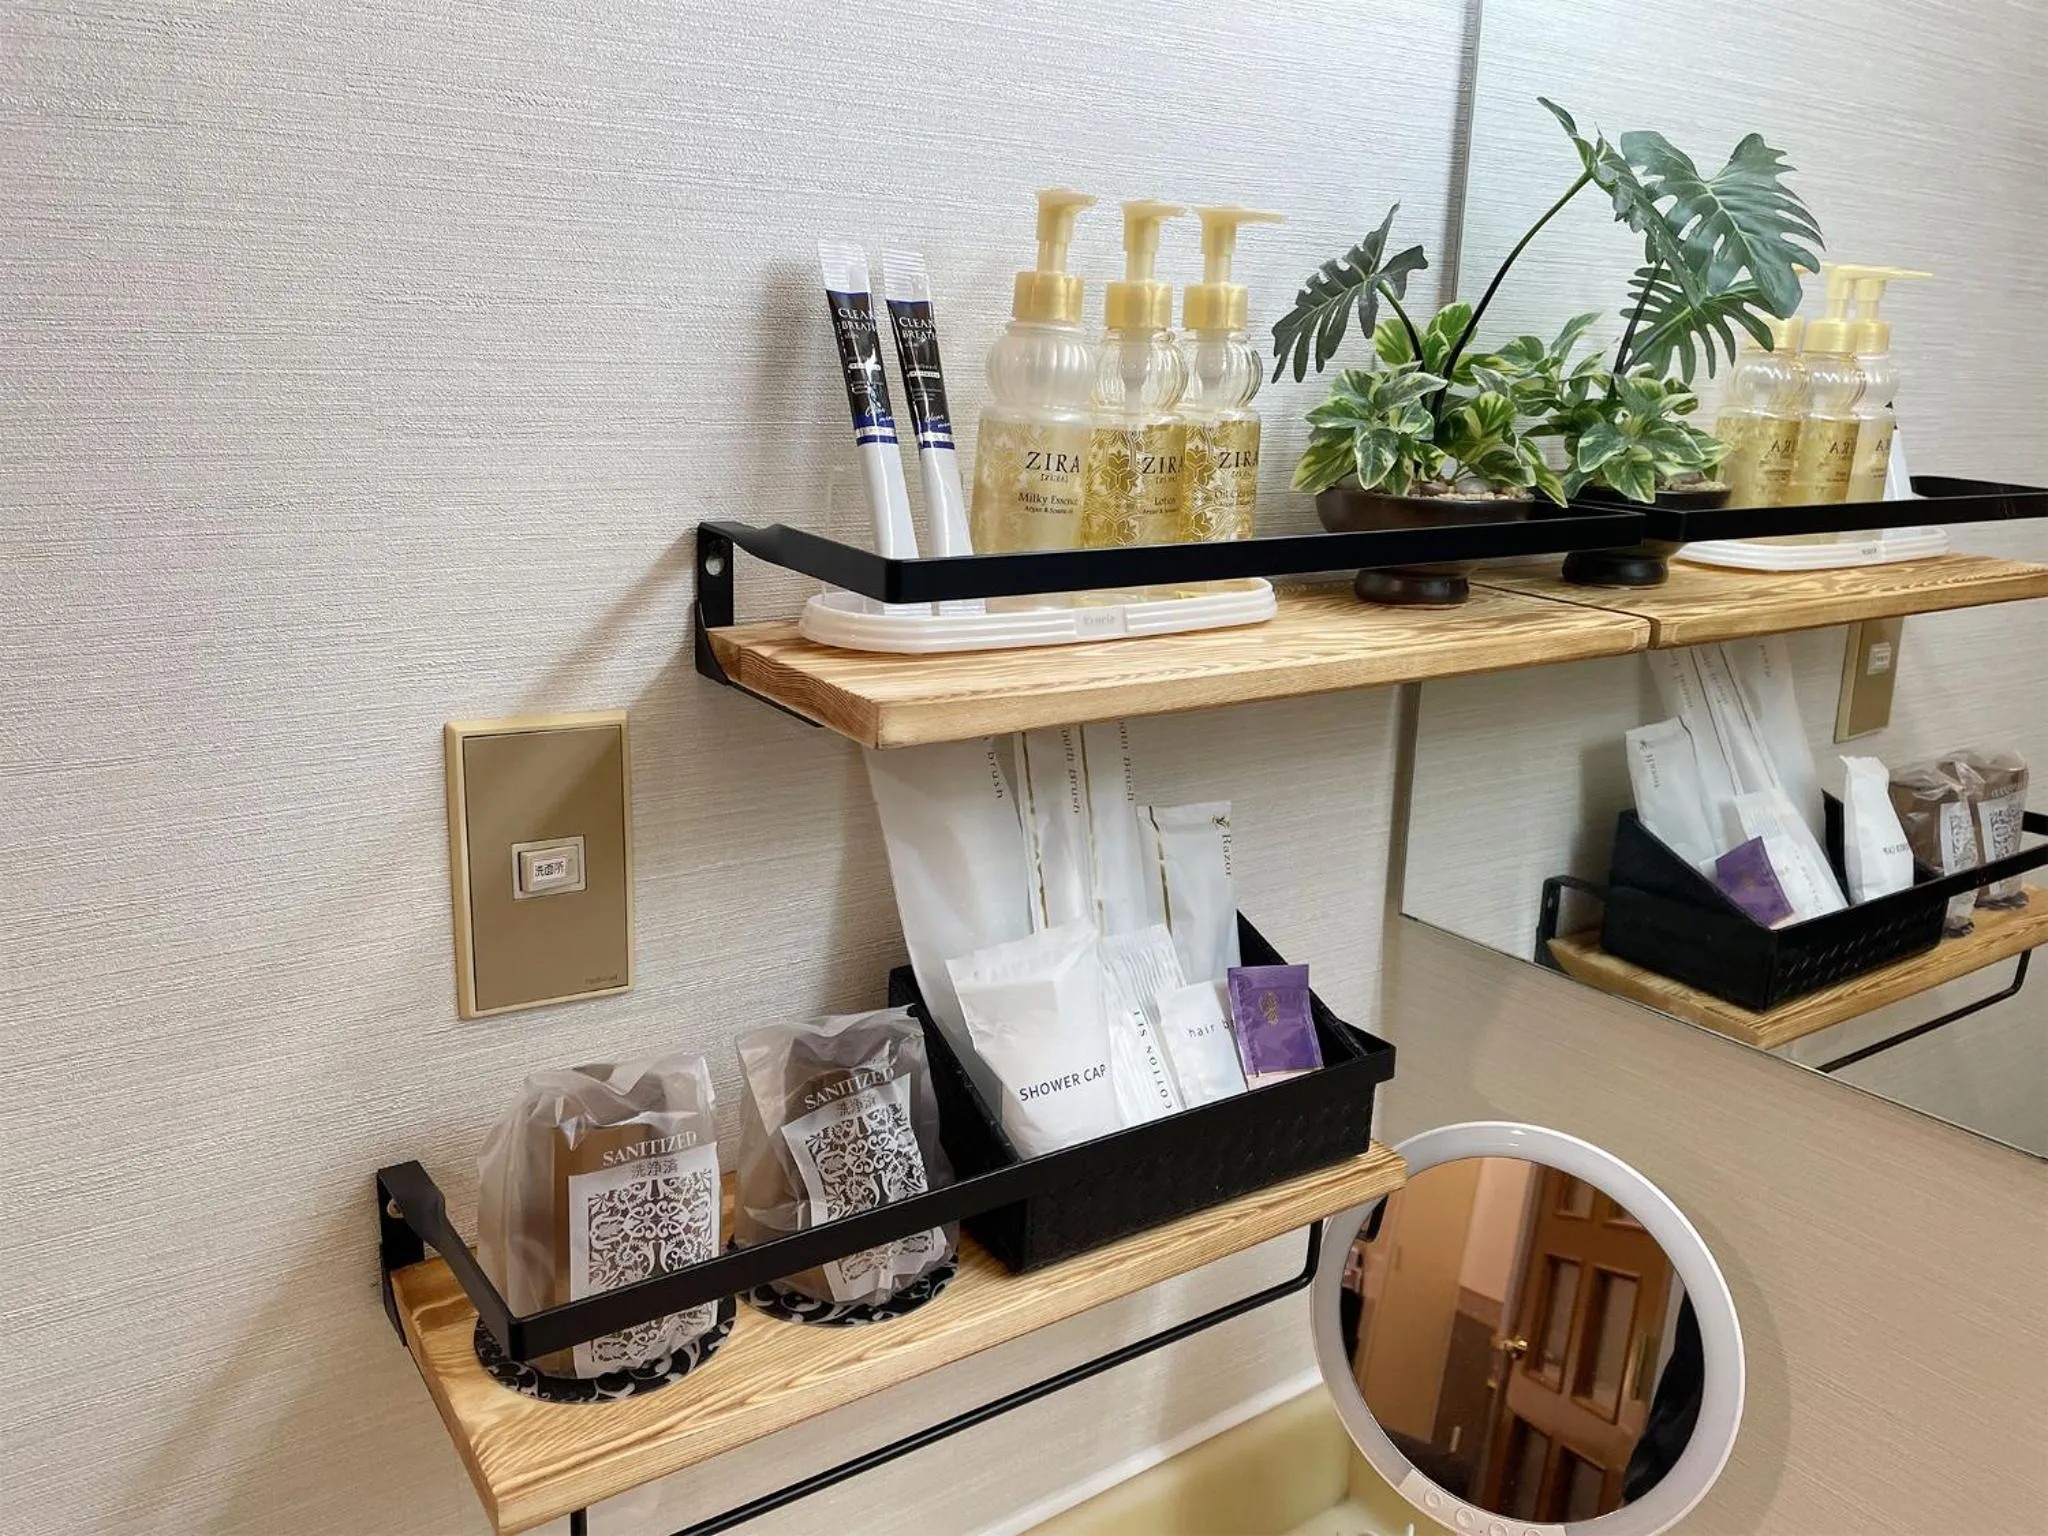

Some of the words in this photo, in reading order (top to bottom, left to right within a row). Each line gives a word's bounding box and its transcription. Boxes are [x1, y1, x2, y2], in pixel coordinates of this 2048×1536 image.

[1025, 451, 1080, 473] ZIRA
[1018, 492, 1048, 506] Milky
[1061, 729, 1075, 762] ooth
[1222, 834, 1232, 875] Razor
[1188, 1024, 1215, 1038] hair
[803, 1066, 895, 1111] SANITIZED
[1019, 1073, 1081, 1101] SHOWER
[1083, 1063, 1106, 1082] CAP
[602, 1130, 697, 1168] SANITIZED
